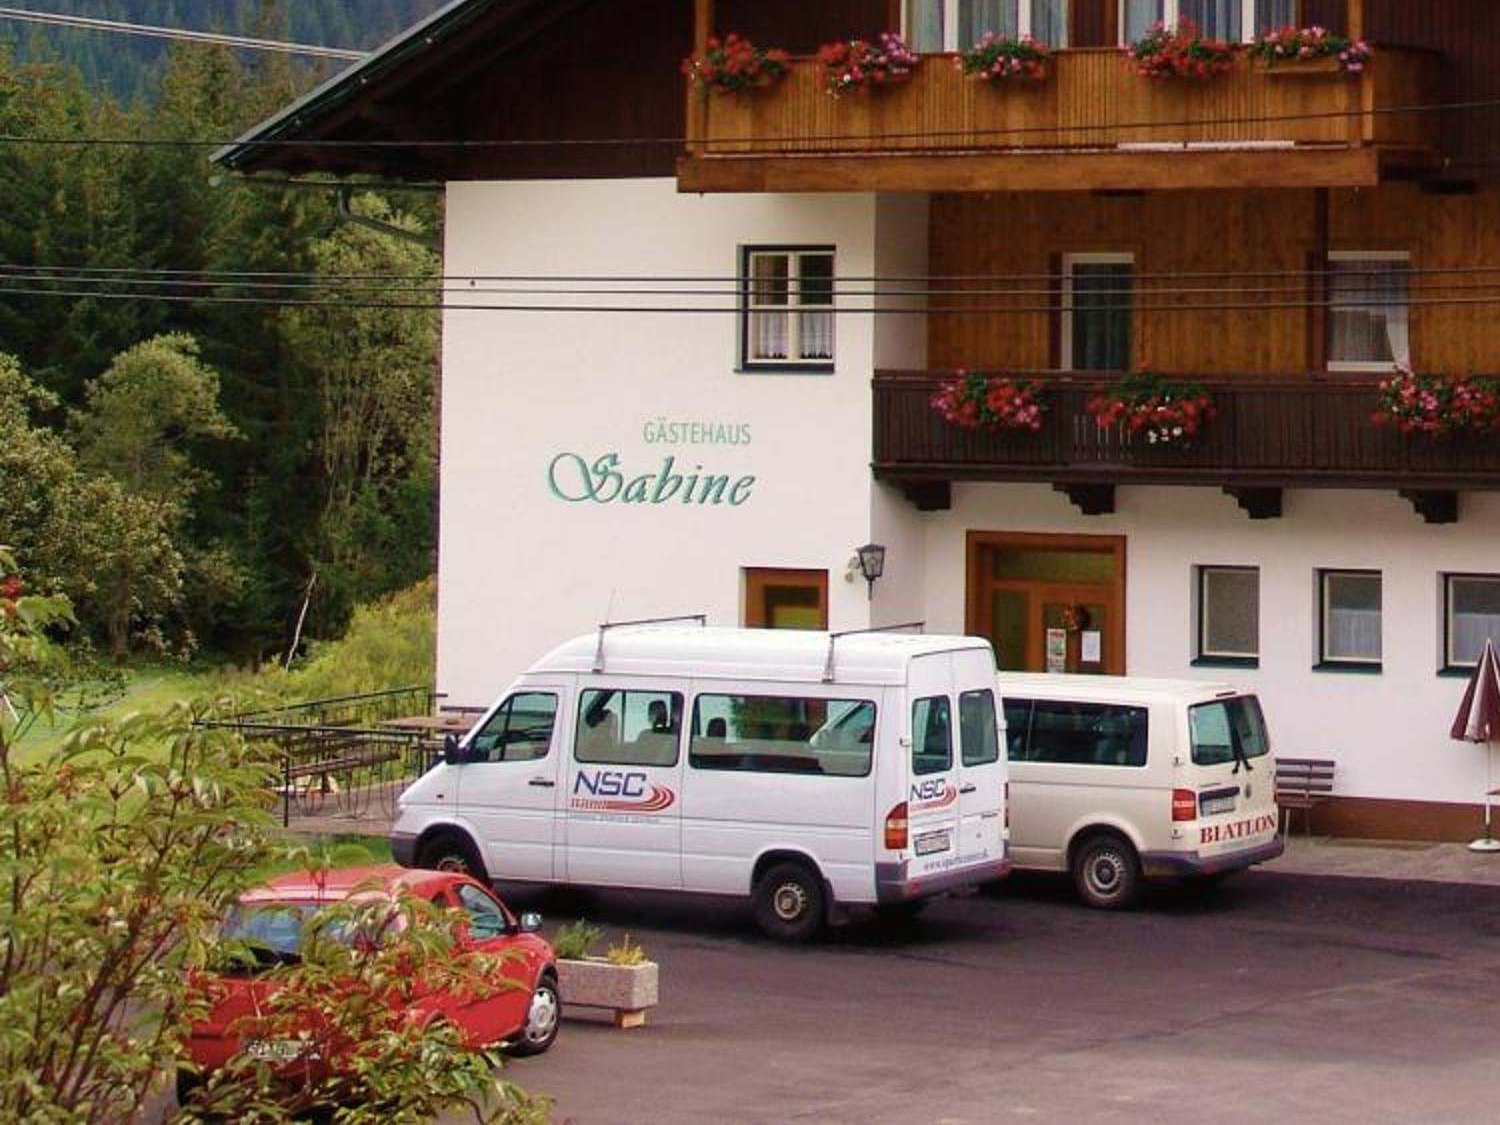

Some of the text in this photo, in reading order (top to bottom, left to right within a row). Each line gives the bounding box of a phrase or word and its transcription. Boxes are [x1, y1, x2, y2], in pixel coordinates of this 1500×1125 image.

[643, 416, 751, 445] GÄSTEHAUS
[548, 451, 755, 506] Sabine
[574, 770, 647, 797] NSC
[1200, 813, 1277, 844] BIATLON
